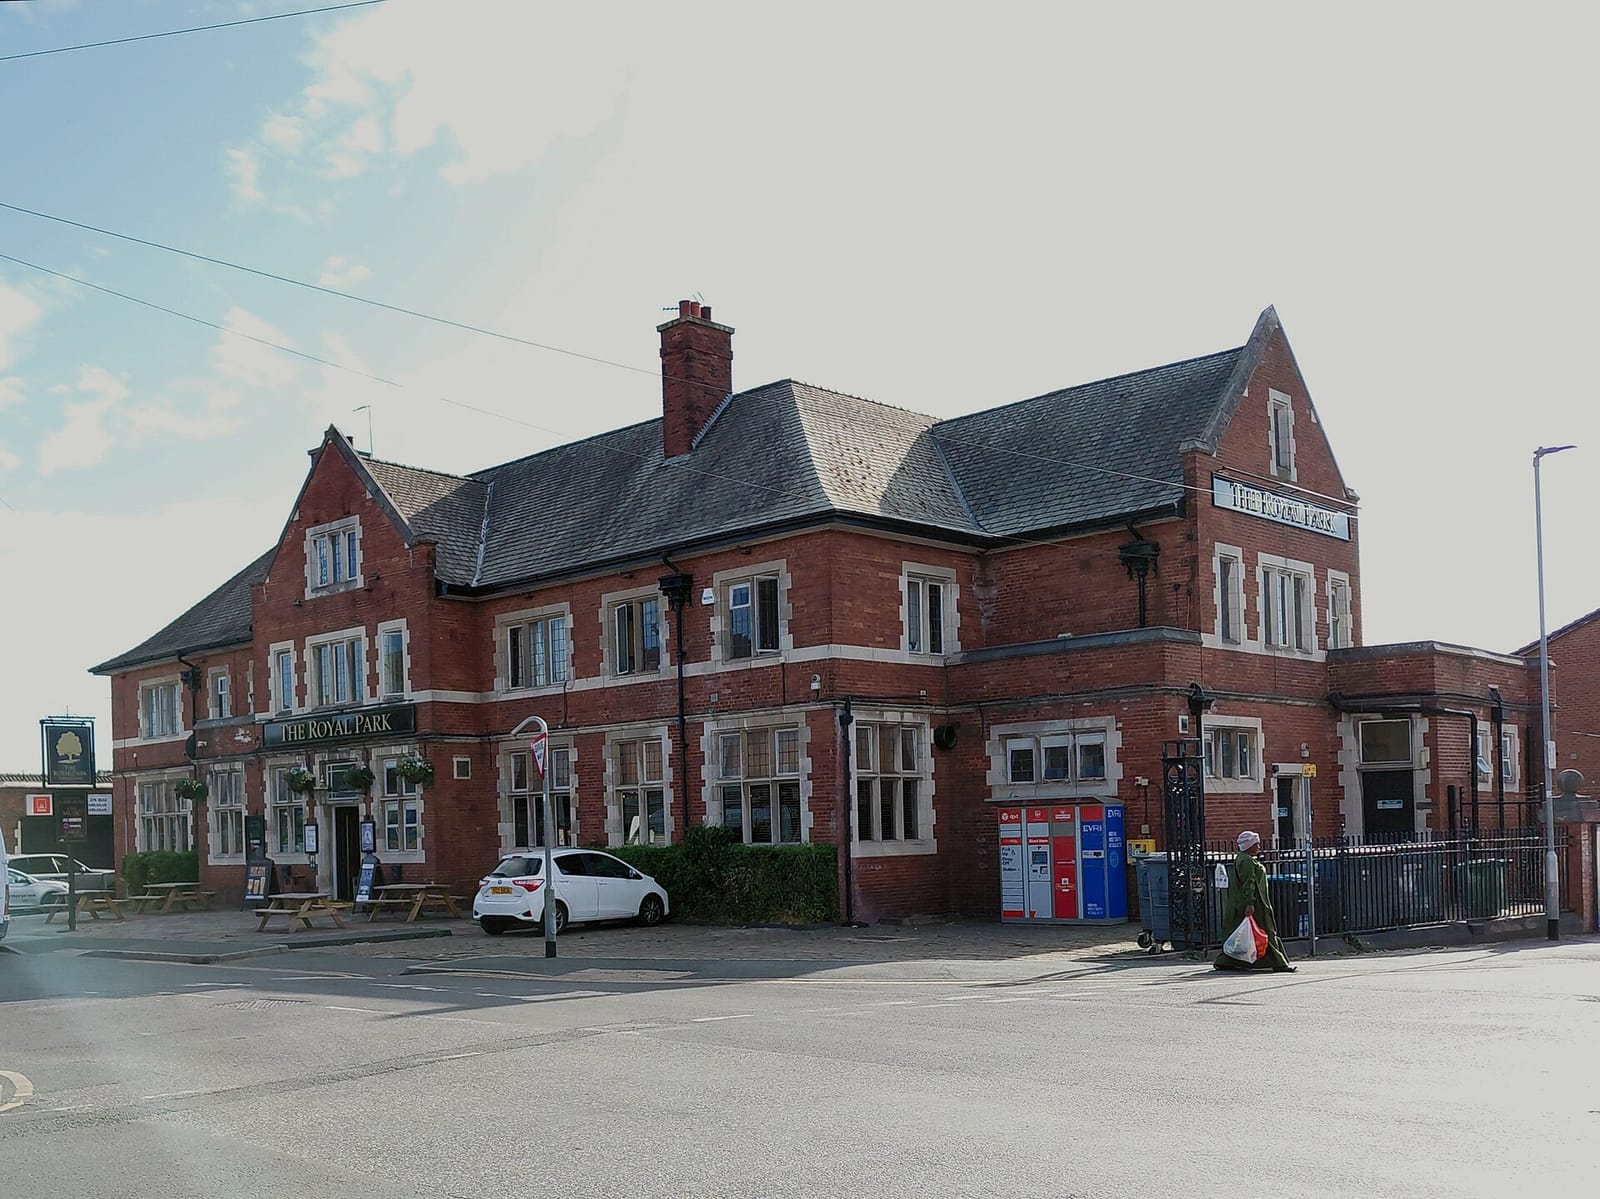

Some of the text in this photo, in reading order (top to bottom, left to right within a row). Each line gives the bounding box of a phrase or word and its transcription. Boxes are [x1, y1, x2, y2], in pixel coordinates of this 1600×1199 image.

[1230, 482, 1336, 534] THE ROYAL PARK
[281, 713, 392, 742] THE ROYAL PARK
